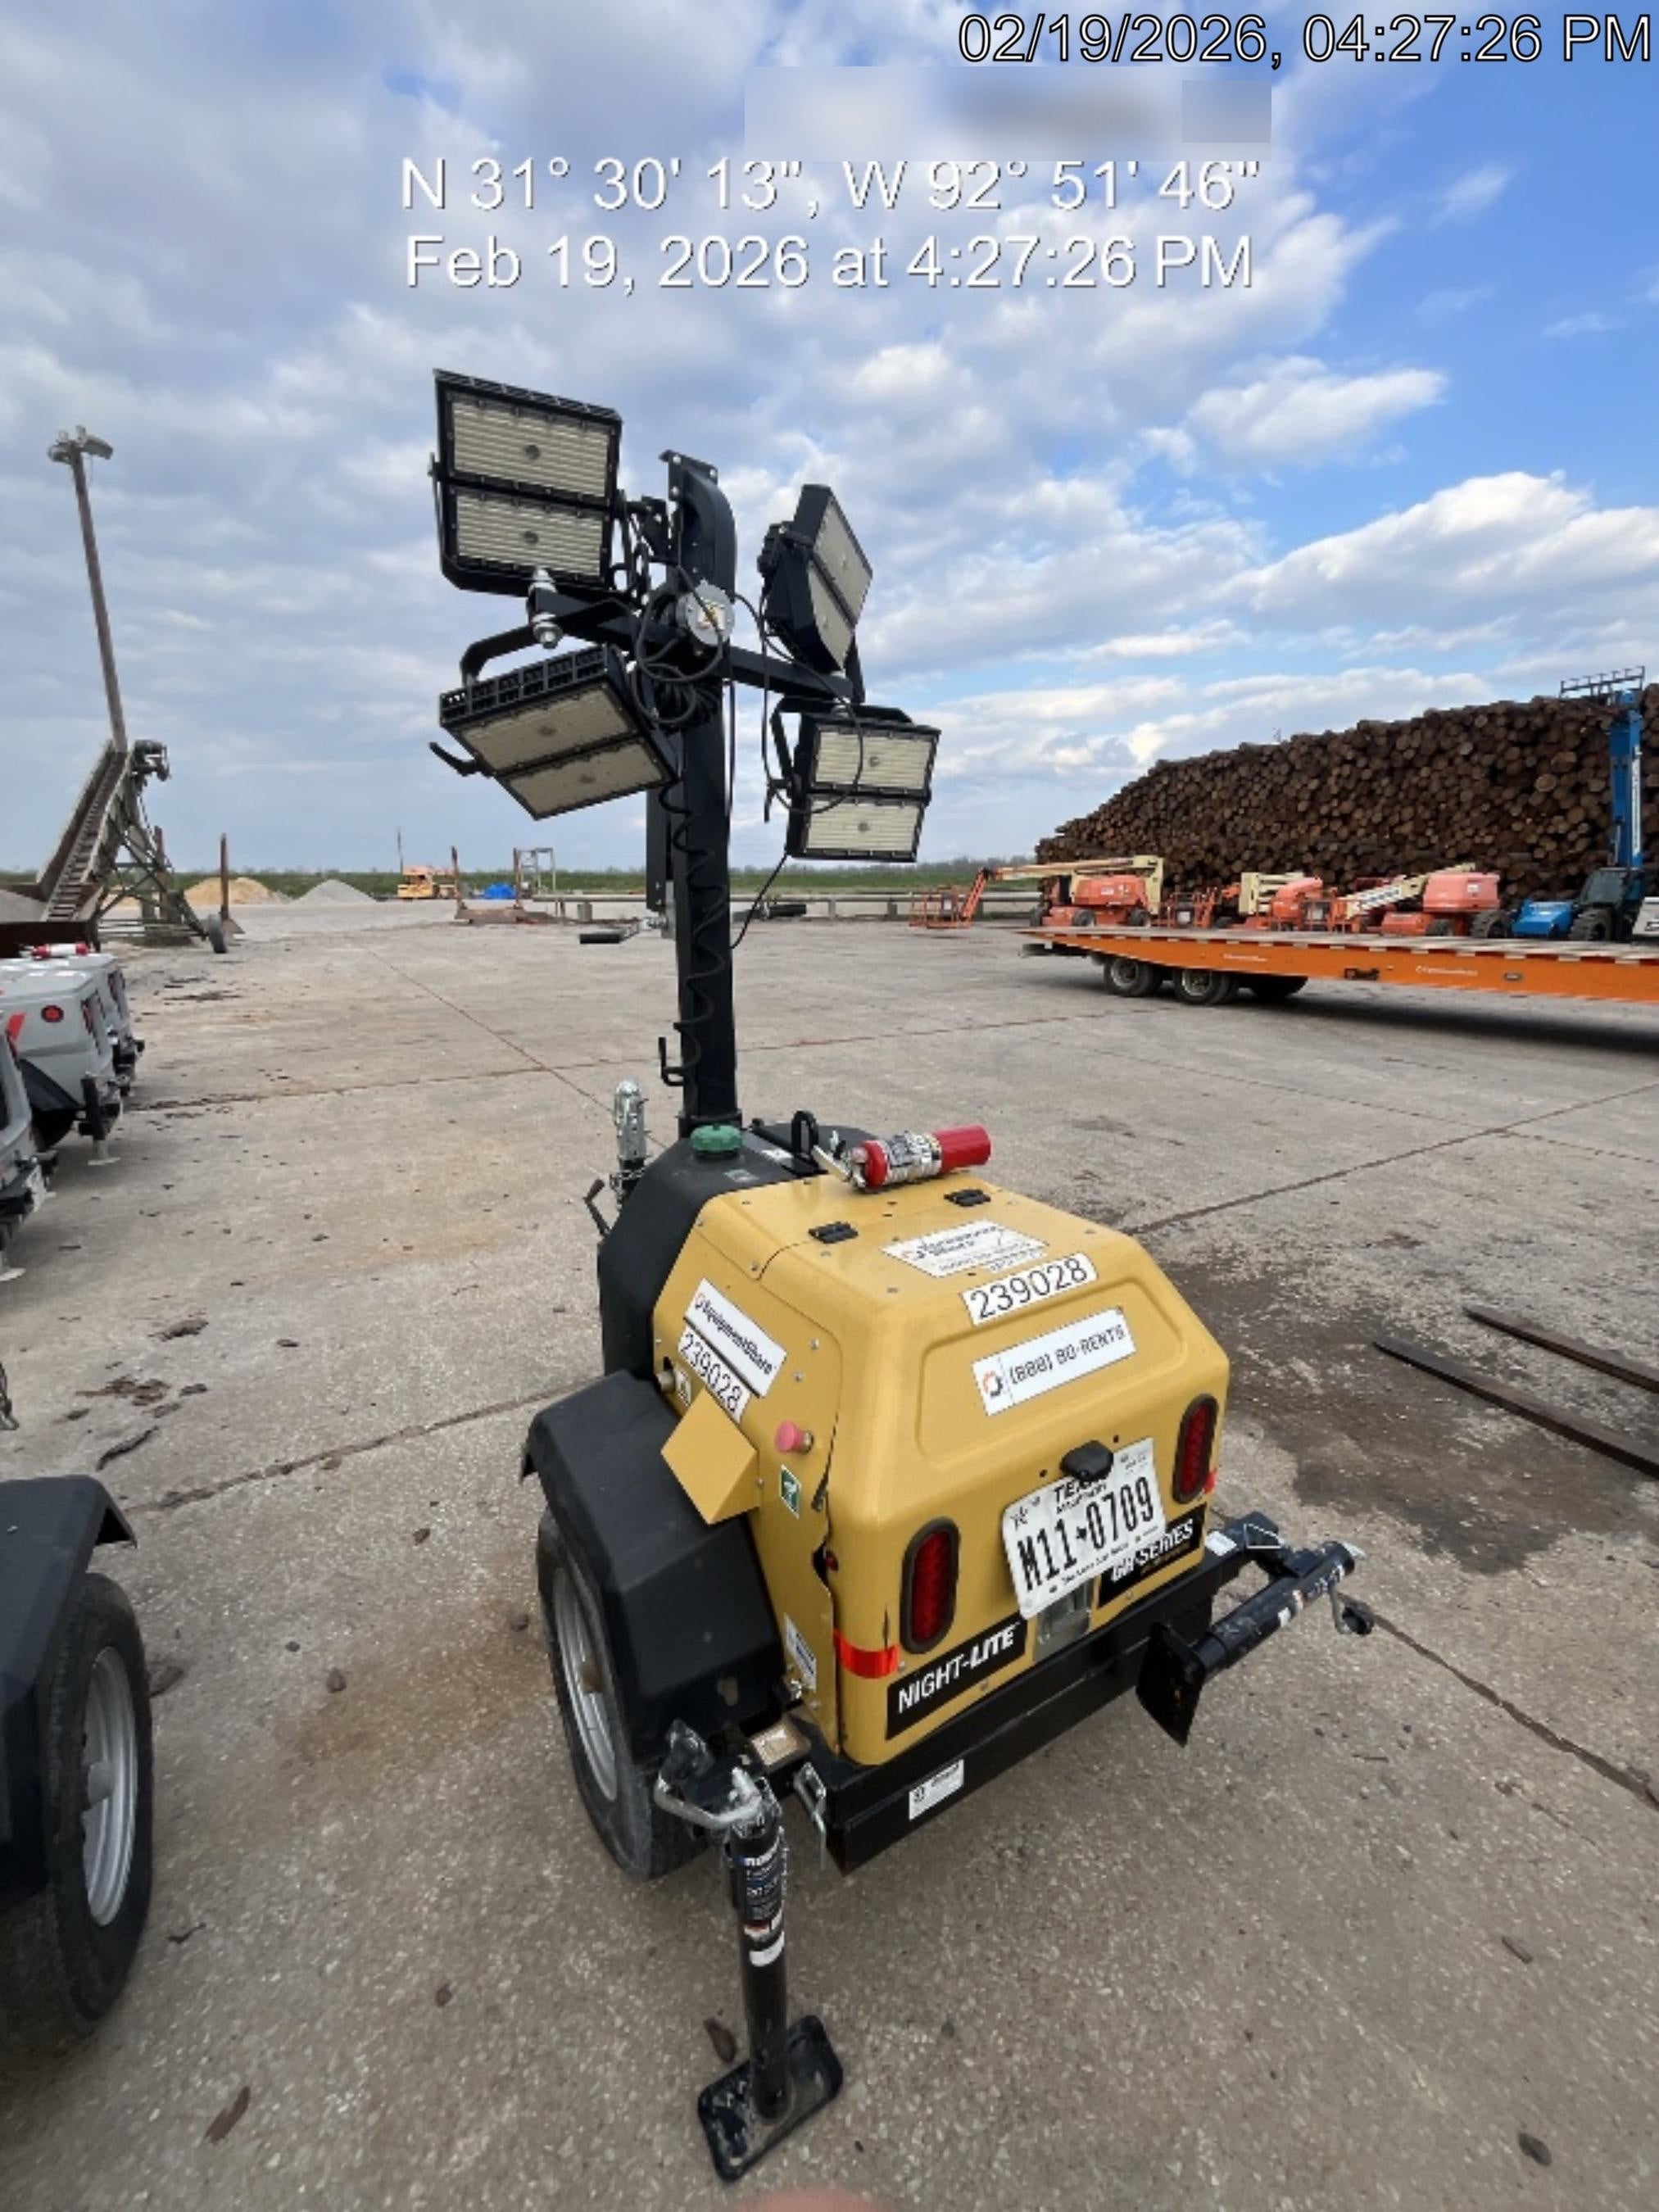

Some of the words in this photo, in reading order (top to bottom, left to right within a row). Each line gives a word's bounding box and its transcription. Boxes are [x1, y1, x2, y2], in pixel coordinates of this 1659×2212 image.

[970, 1258, 1088, 1320] 239028
[681, 1333, 742, 1414] 239028
[899, 1628, 1015, 1714] NIGHT-LITE
